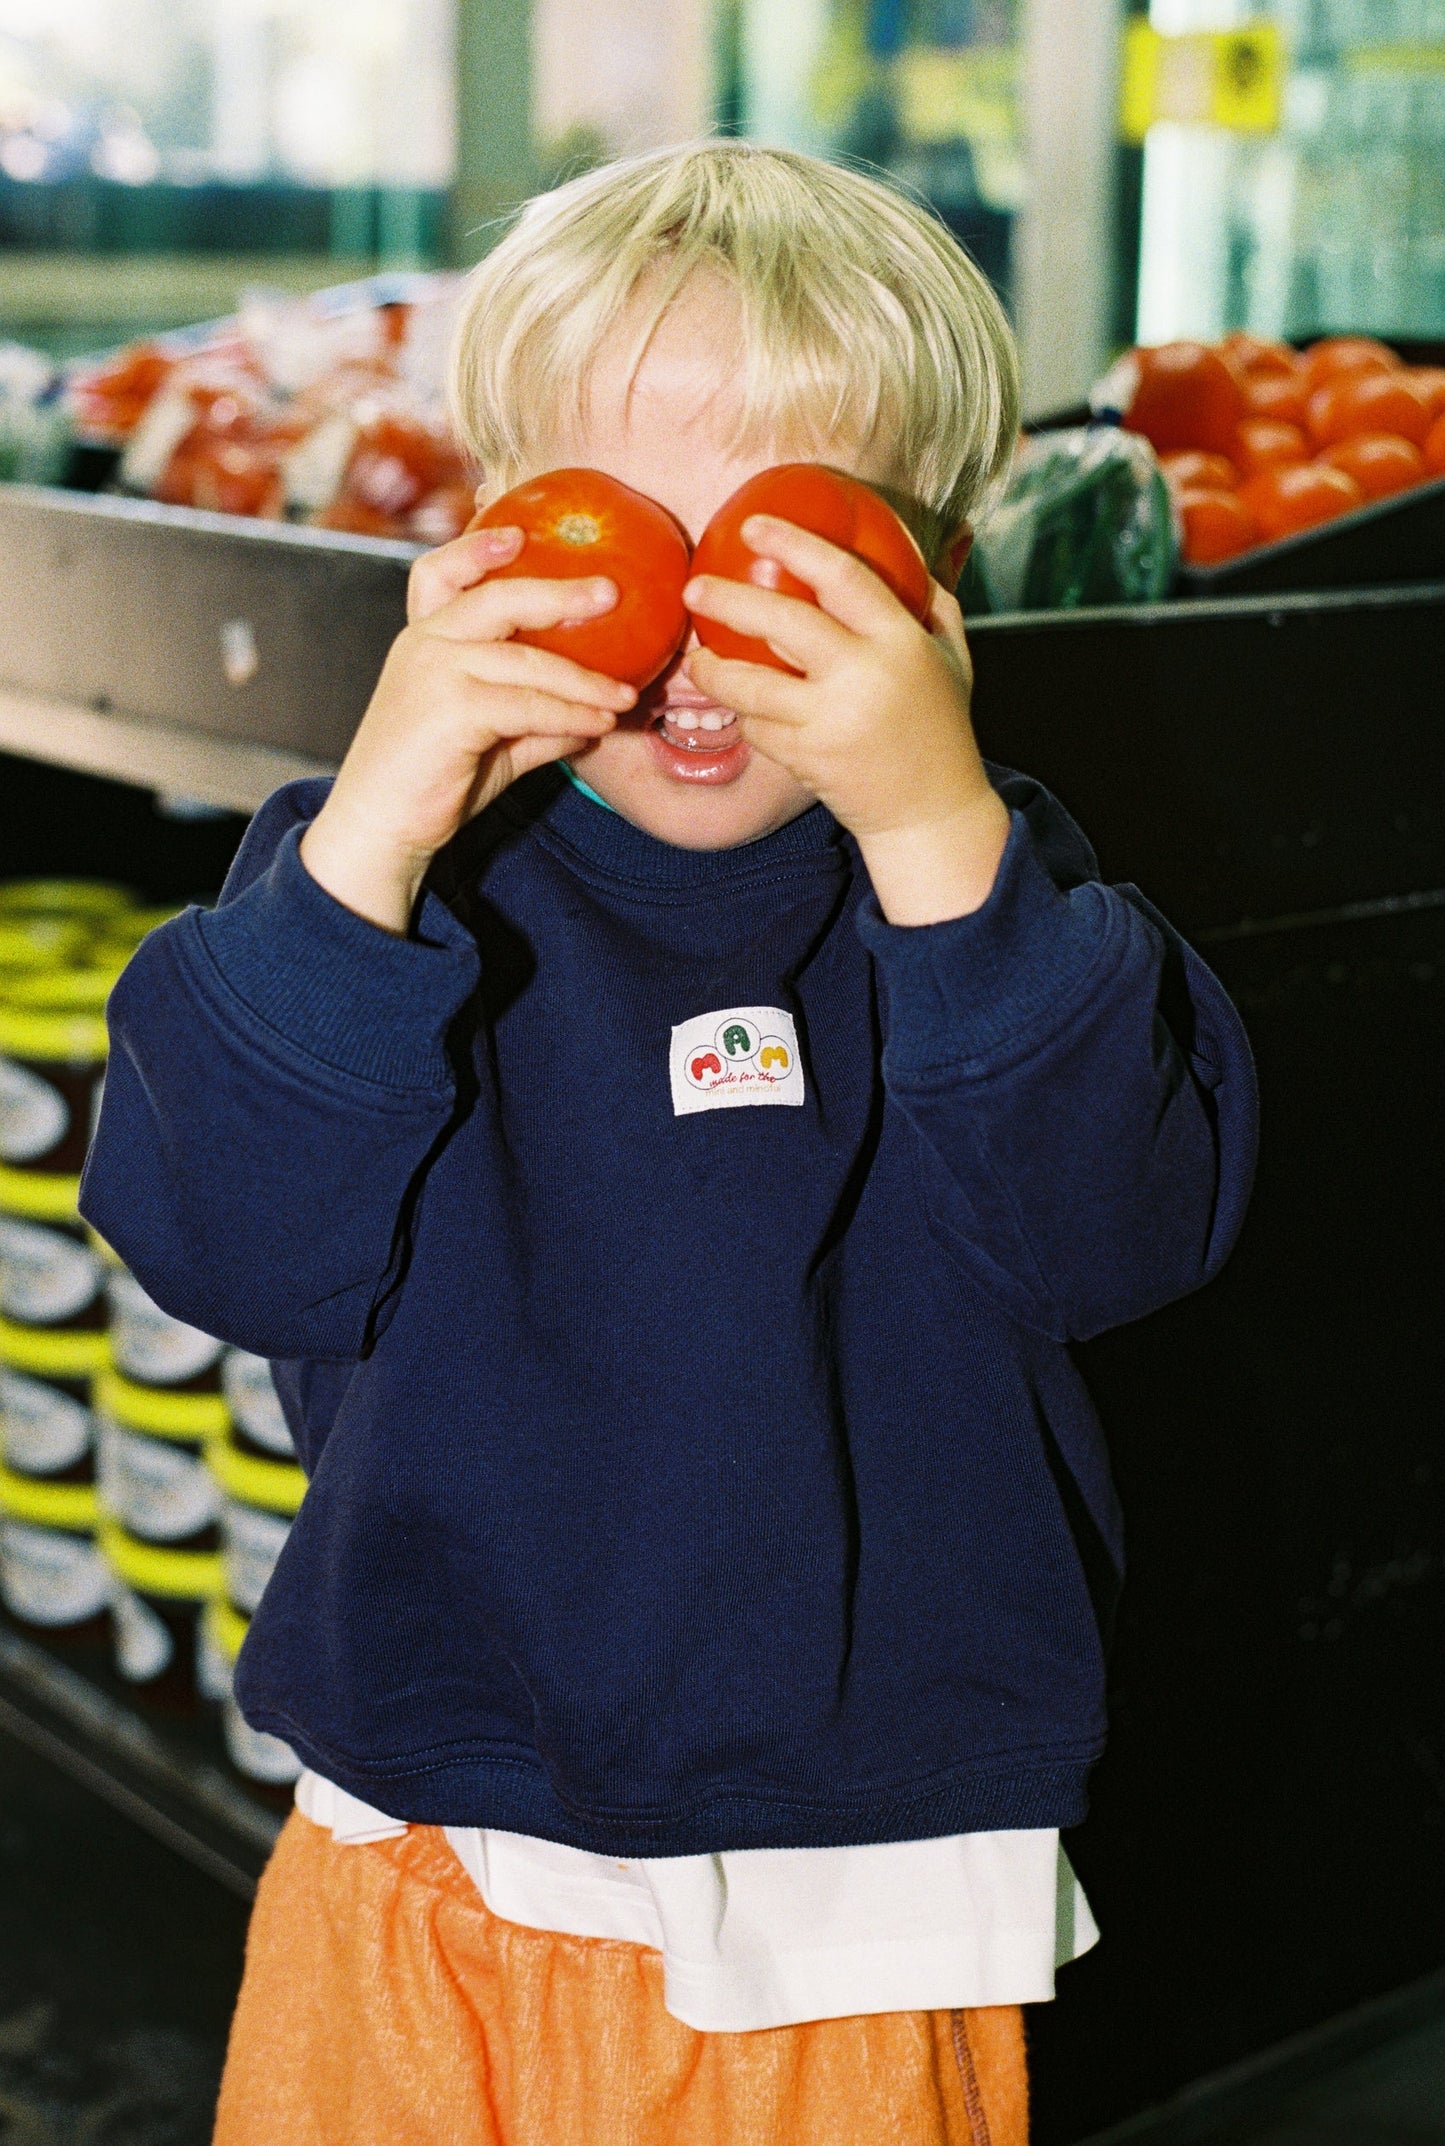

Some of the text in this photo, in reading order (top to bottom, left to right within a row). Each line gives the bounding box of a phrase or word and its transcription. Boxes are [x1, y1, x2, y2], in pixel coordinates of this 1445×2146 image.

[710, 1072, 776, 1087] made for the
